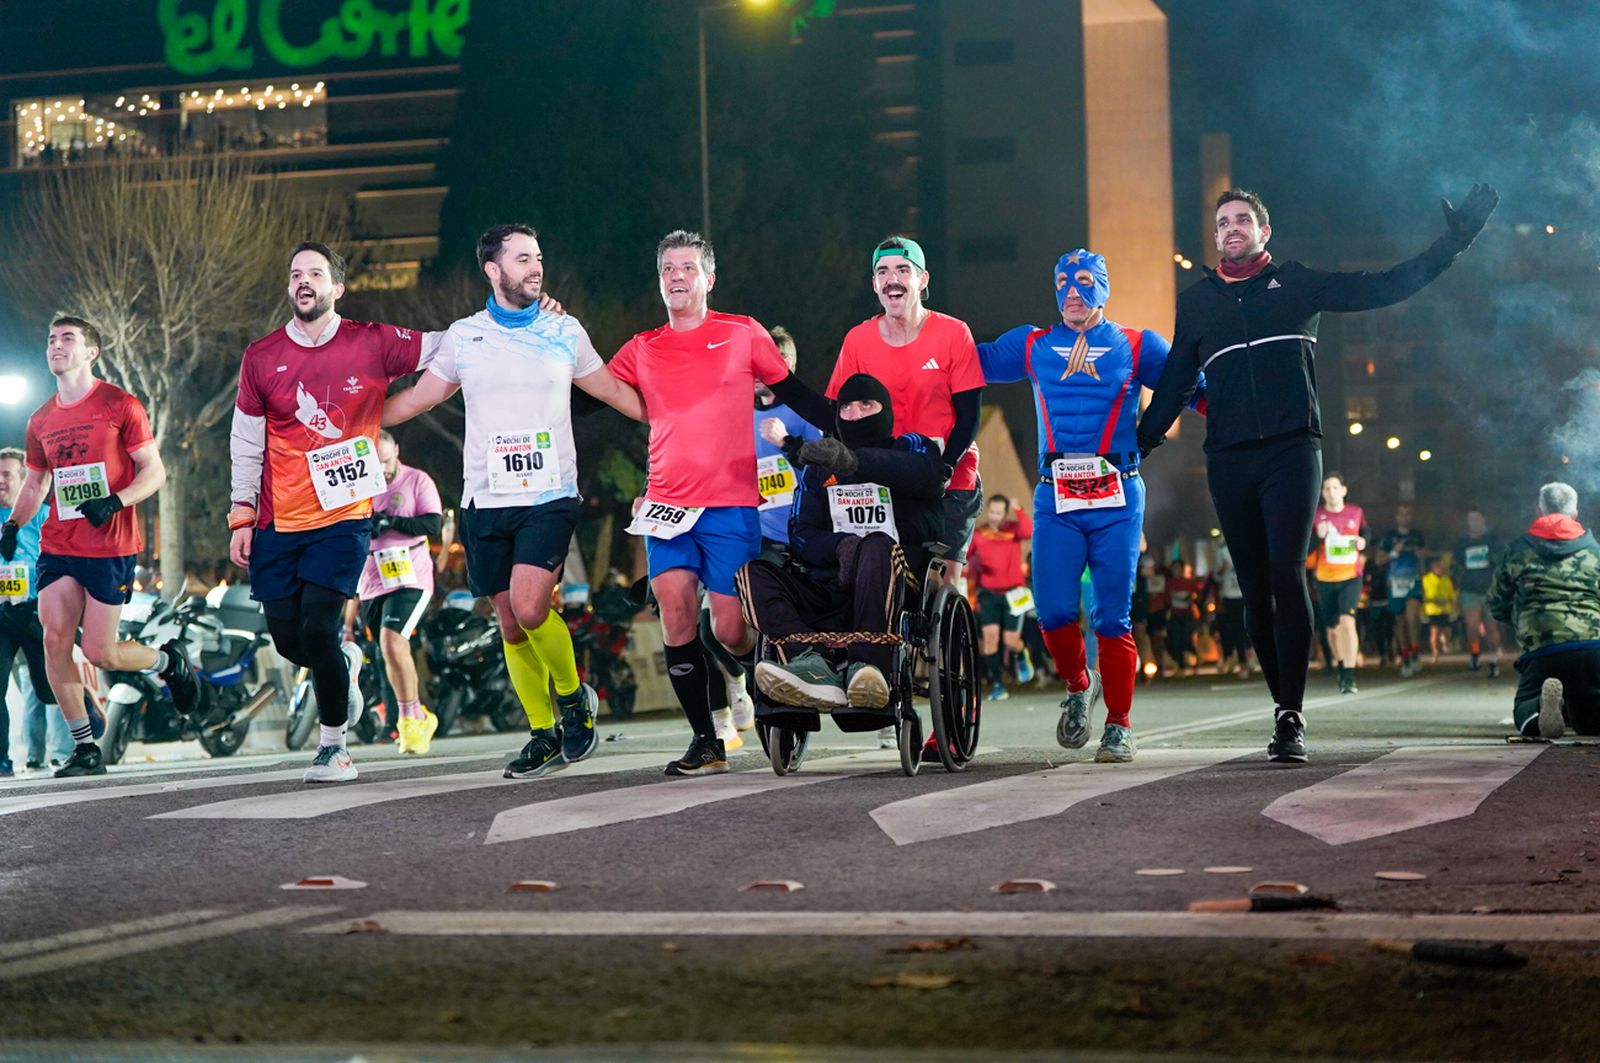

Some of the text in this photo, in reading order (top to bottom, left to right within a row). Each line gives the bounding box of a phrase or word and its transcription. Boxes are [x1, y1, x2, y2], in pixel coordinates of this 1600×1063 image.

[259, 0, 470, 68] Corte
[309, 414, 327, 431] 43
[502, 451, 544, 472] 1610
[325, 459, 368, 487] 3152
[62, 482, 102, 501] 12198
[645, 504, 686, 524] 1259
[845, 505, 886, 524] 1076
